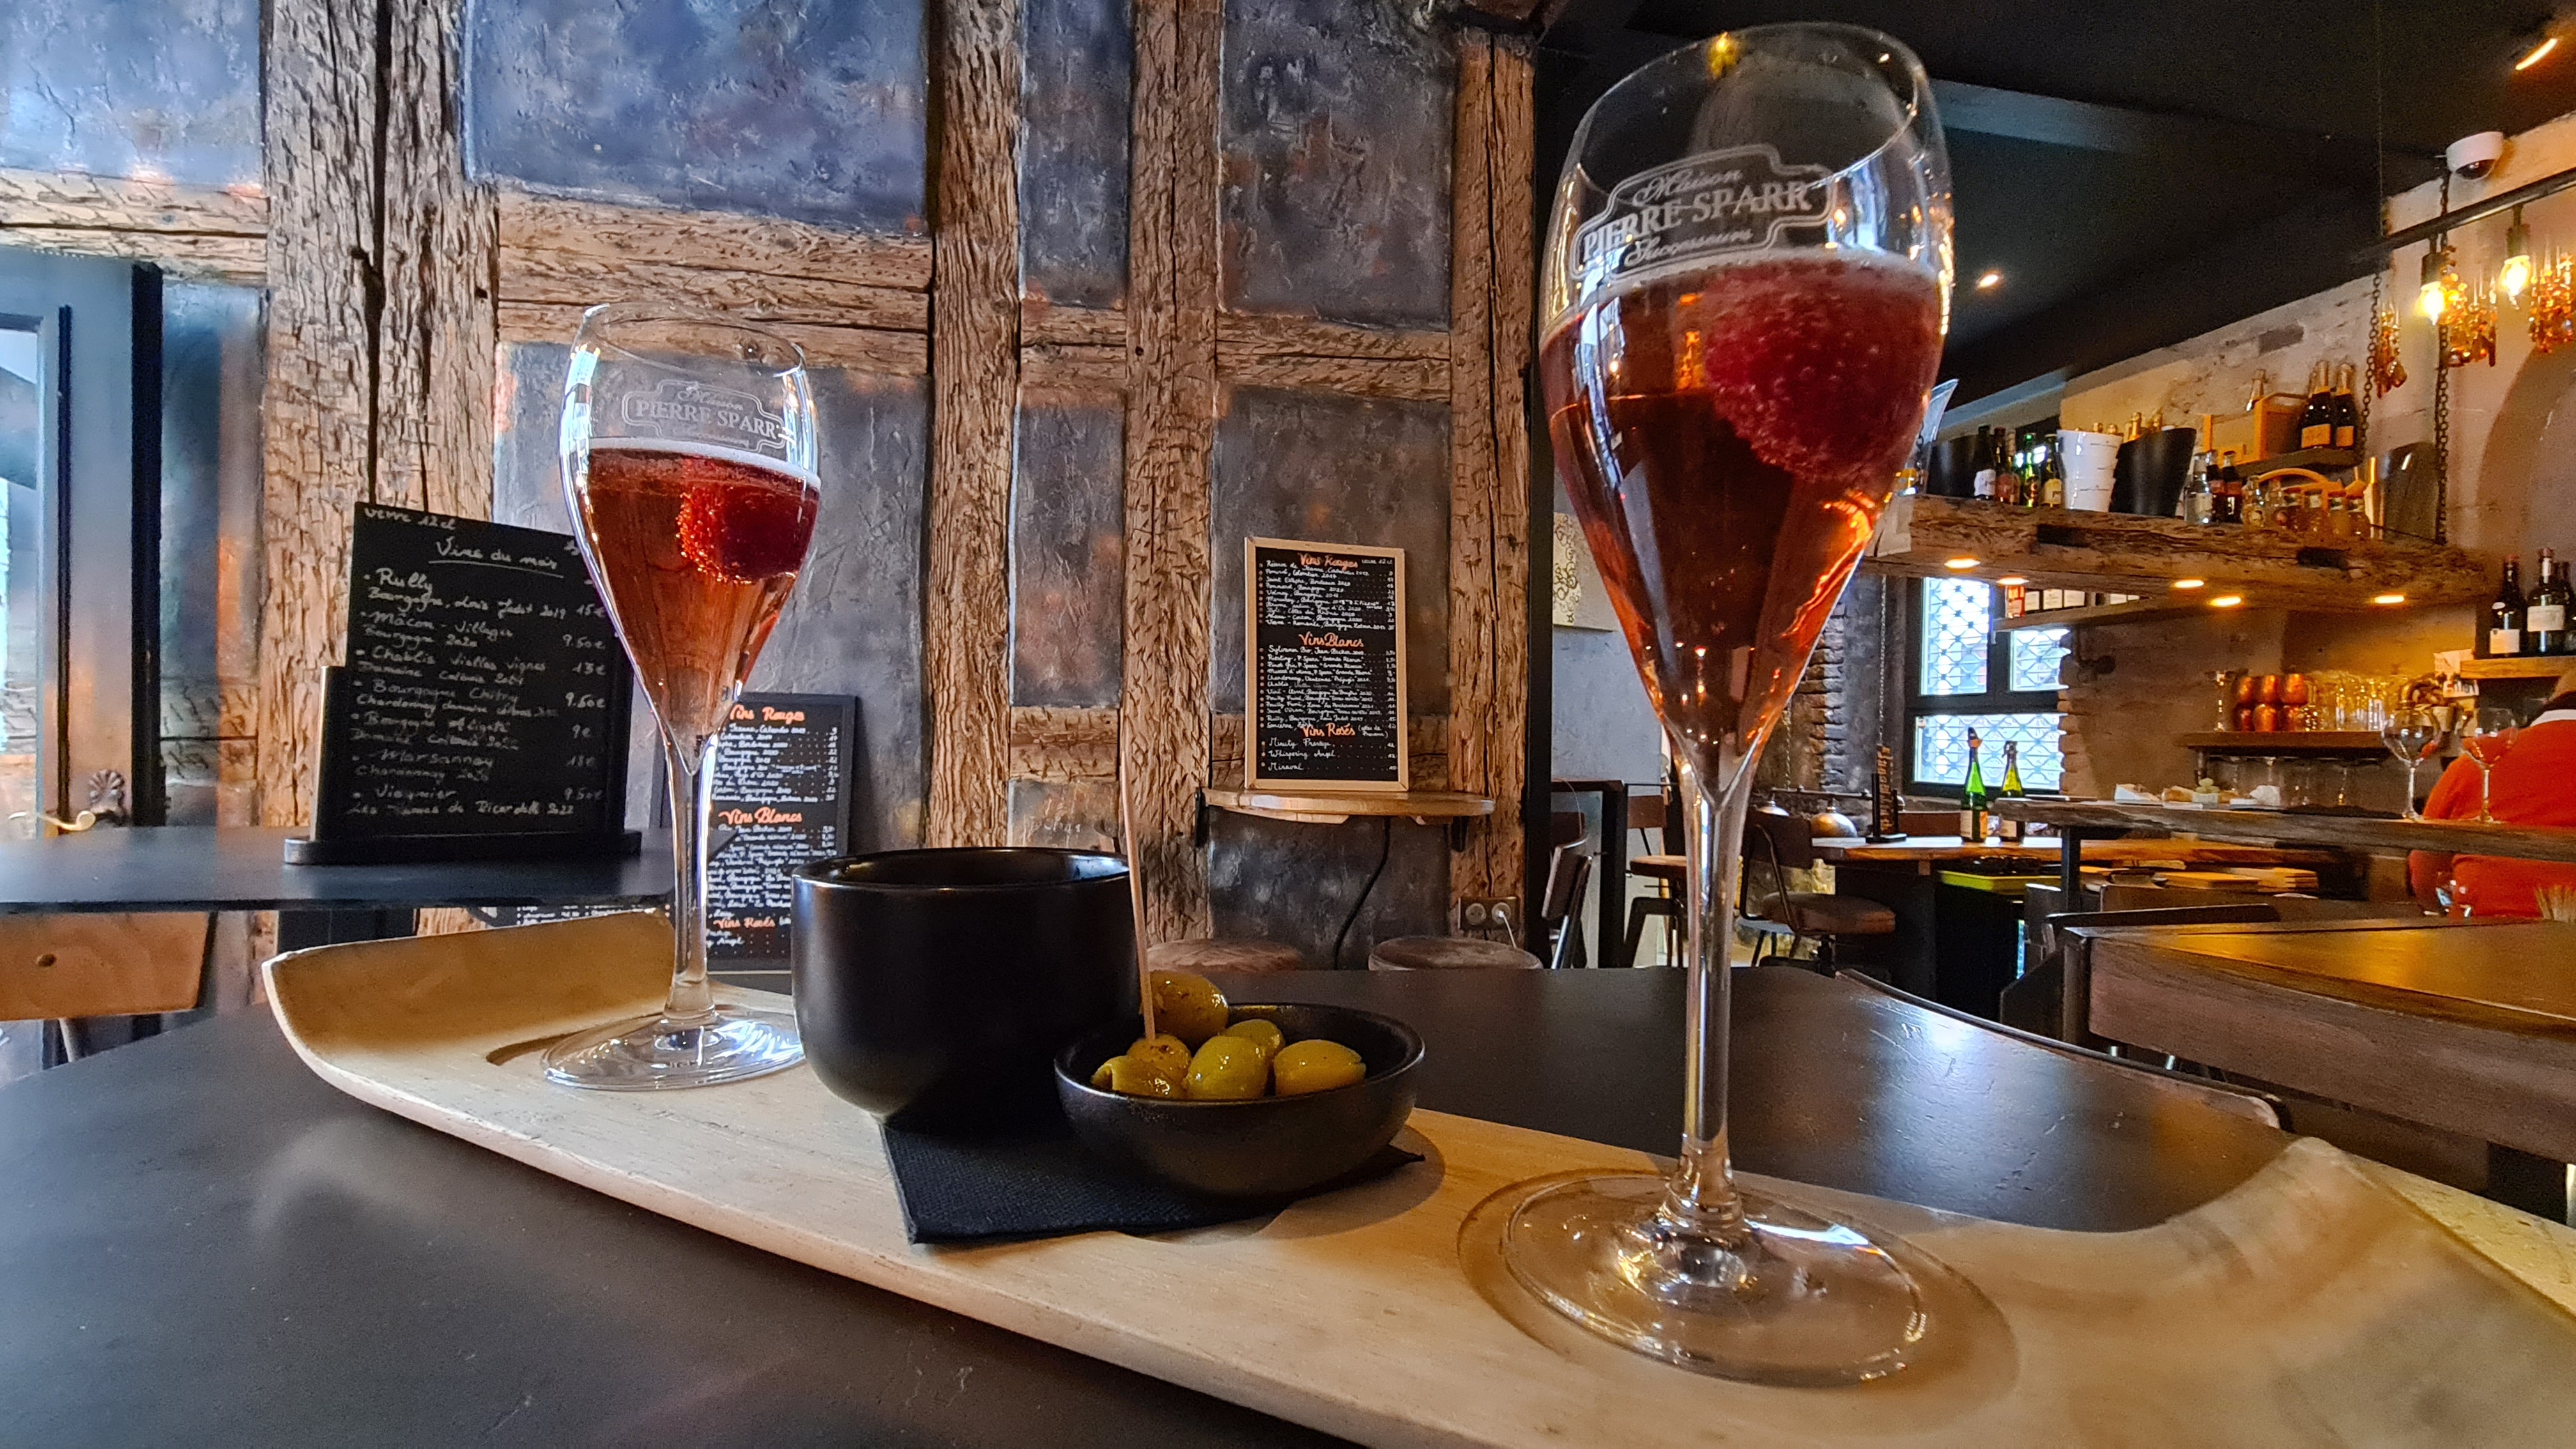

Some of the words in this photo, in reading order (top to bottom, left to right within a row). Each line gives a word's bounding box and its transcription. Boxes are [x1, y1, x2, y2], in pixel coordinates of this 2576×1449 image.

[1583, 198, 1683, 262] PIERRE
[1692, 181, 1813, 223] SPARR
[634, 399, 712, 423] PIERRE
[717, 410, 778, 440] SPARR
[418, 516, 438, 526] 12
[436, 536, 484, 559] Vins
[490, 548, 511, 563] du
[519, 556, 558, 570] mois
[1298, 552, 1321, 566] Vins
[1324, 555, 1358, 571] Rouges
[375, 567, 433, 595] Rully
[1298, 631, 1325, 646] Vins
[1324, 632, 1364, 648] Blancs
[371, 645, 436, 665] Chablis
[762, 706, 806, 724] Rouges
[1300, 723, 1325, 737] Vins
[1324, 722, 1356, 737] Rosés
[1269, 737, 1300, 749] Minuty
[1268, 749, 1308, 760] Whispering
[1314, 749, 1336, 759] Angel
[1268, 762, 1304, 772] Miraval
[718, 808, 753, 825] Vins
[754, 806, 803, 824] Blancs
[712, 918, 741, 929] Vins
[743, 916, 776, 928] Rosés
